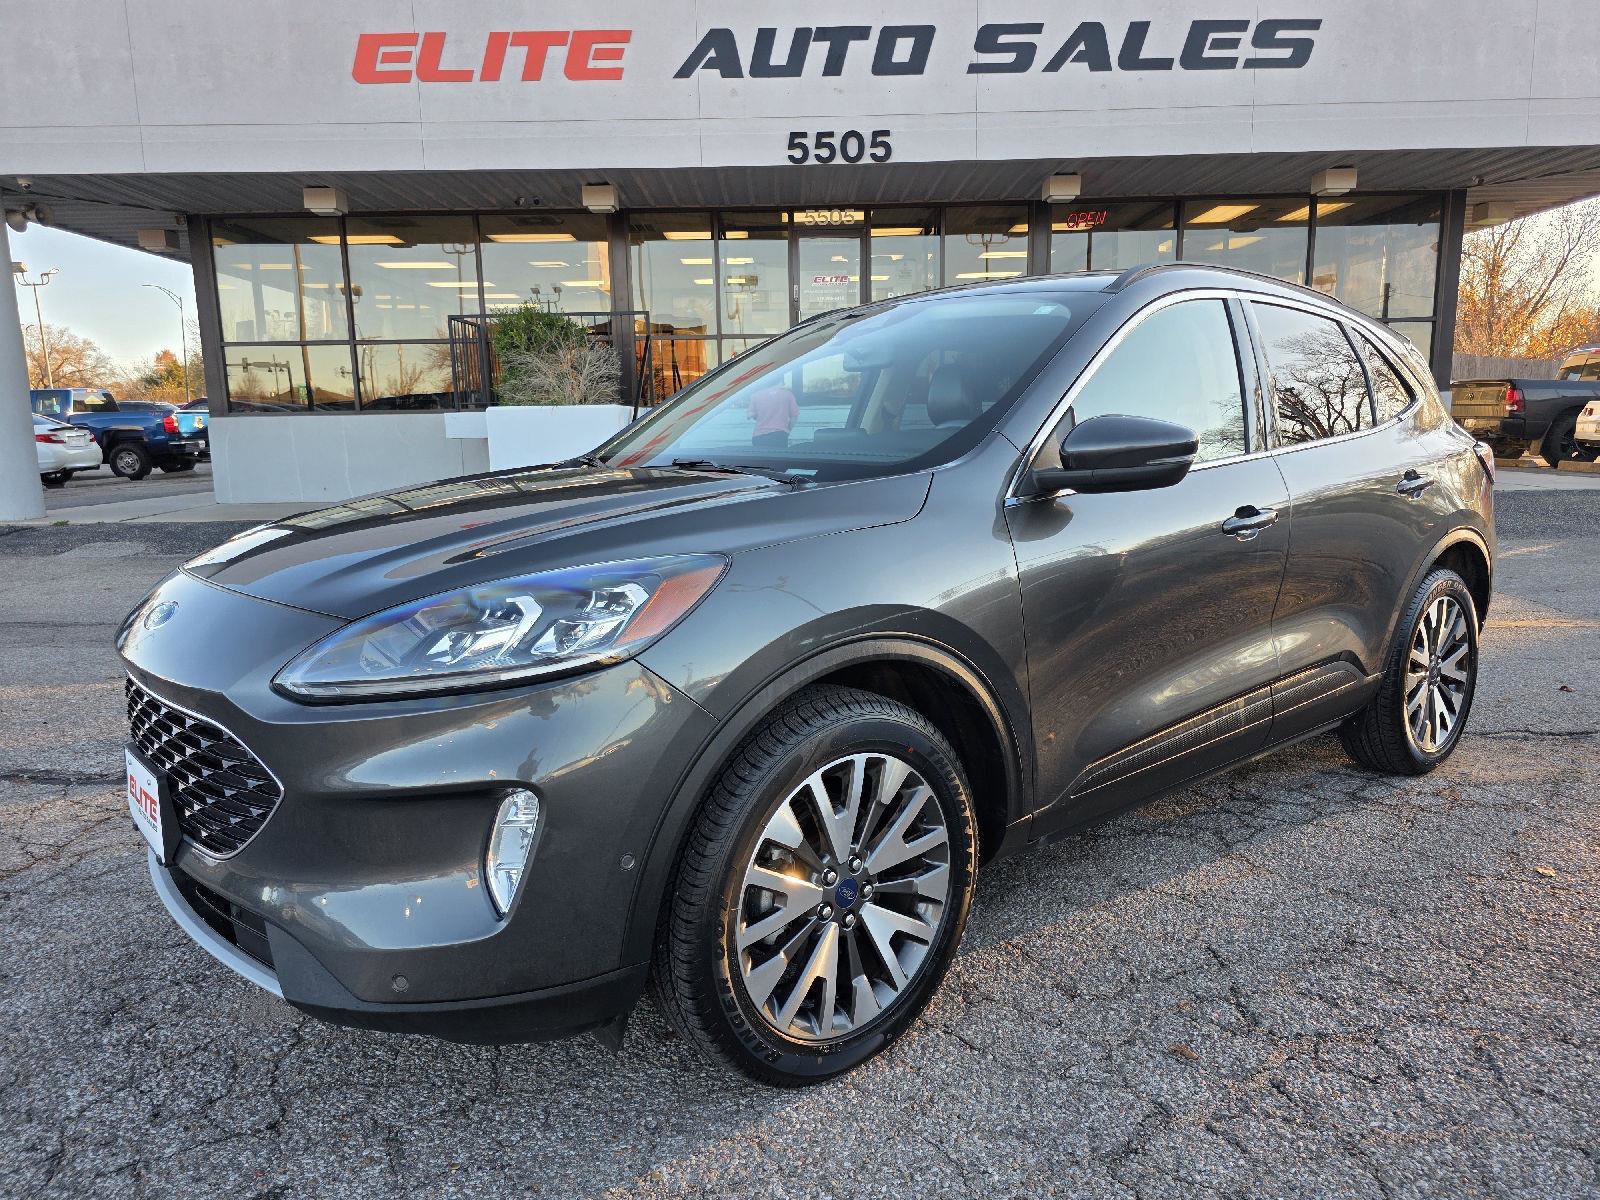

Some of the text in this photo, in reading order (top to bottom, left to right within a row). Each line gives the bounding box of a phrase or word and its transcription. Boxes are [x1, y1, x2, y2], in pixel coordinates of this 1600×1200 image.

[352, 18, 1322, 84] ELITE AUTO SALES
[787, 129, 893, 165] 5505
[804, 208, 855, 226] 5505
[1066, 210, 1107, 229] OPEN
[813, 275, 849, 284] ELITE
[129, 773, 158, 824] ELITE
